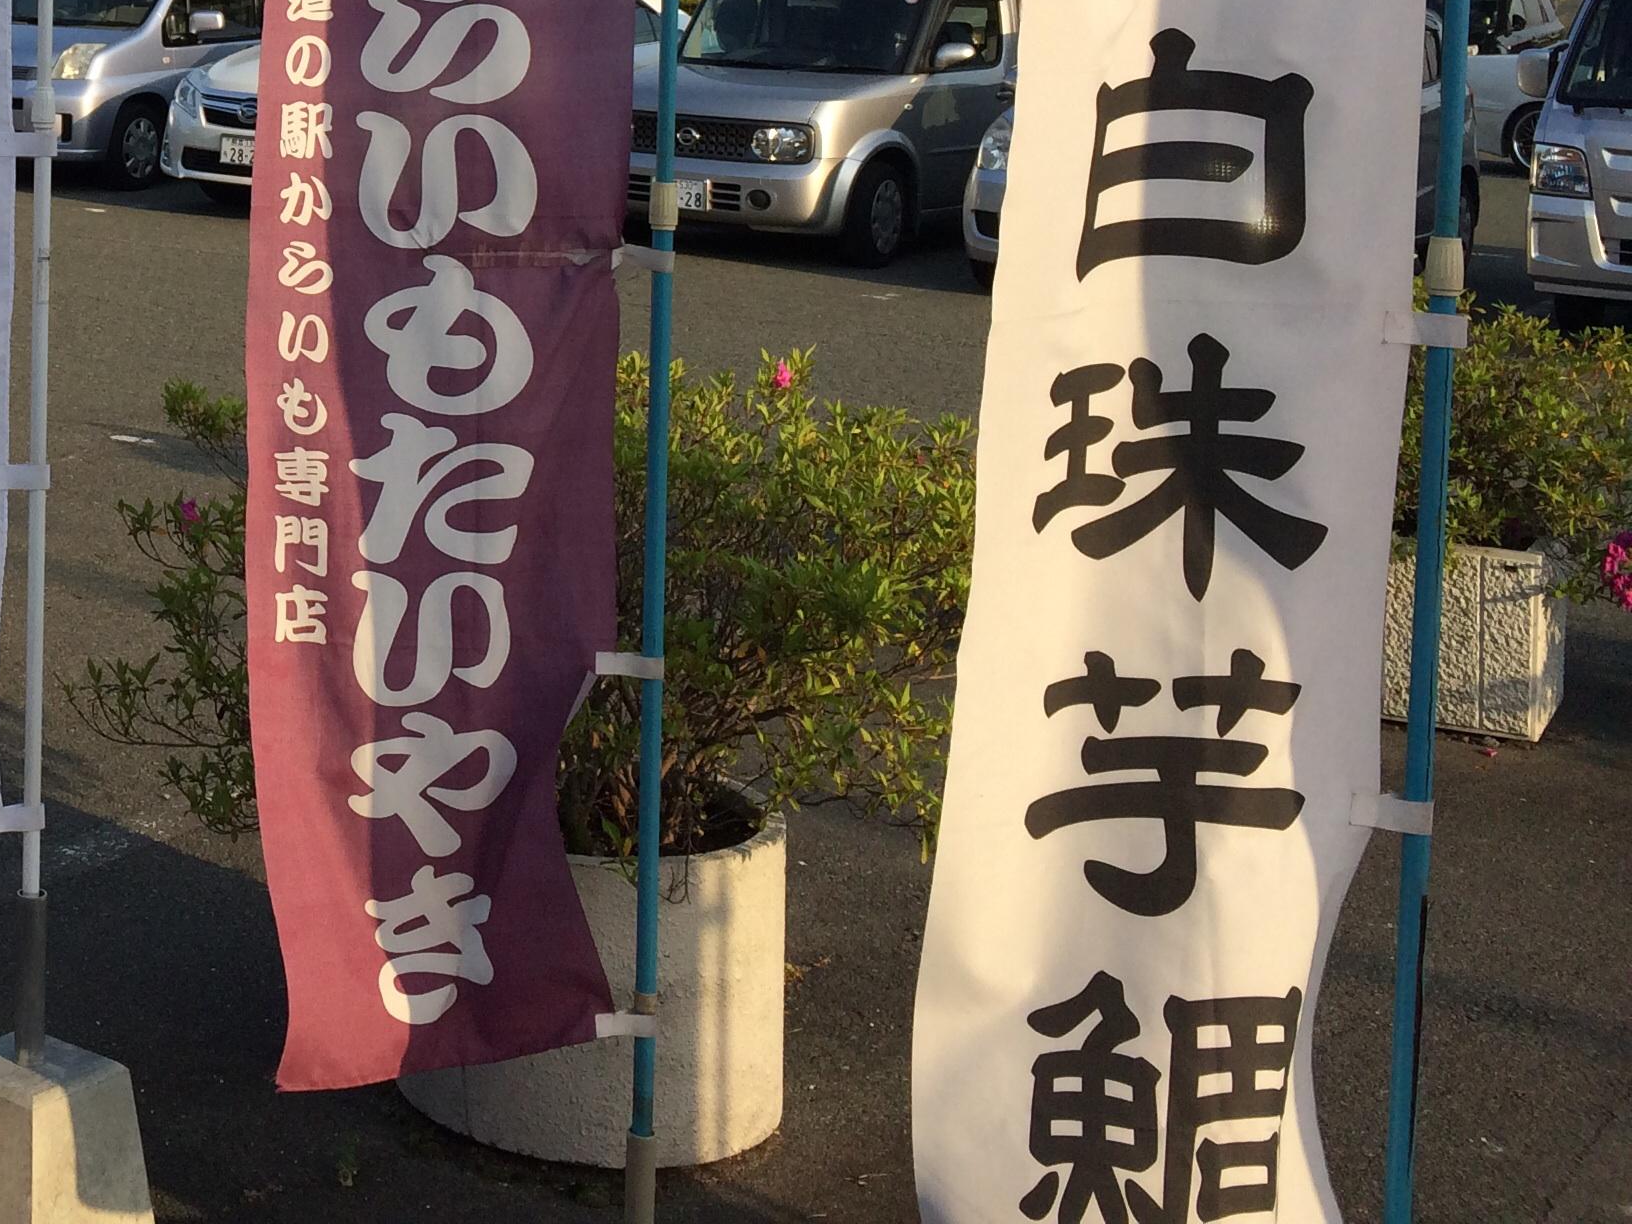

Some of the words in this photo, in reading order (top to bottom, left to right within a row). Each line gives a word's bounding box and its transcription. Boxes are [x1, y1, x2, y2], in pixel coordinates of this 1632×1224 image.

[230, 147, 255, 163] 28-2
[1018, 27, 1330, 1224] 白珠芋鯛
